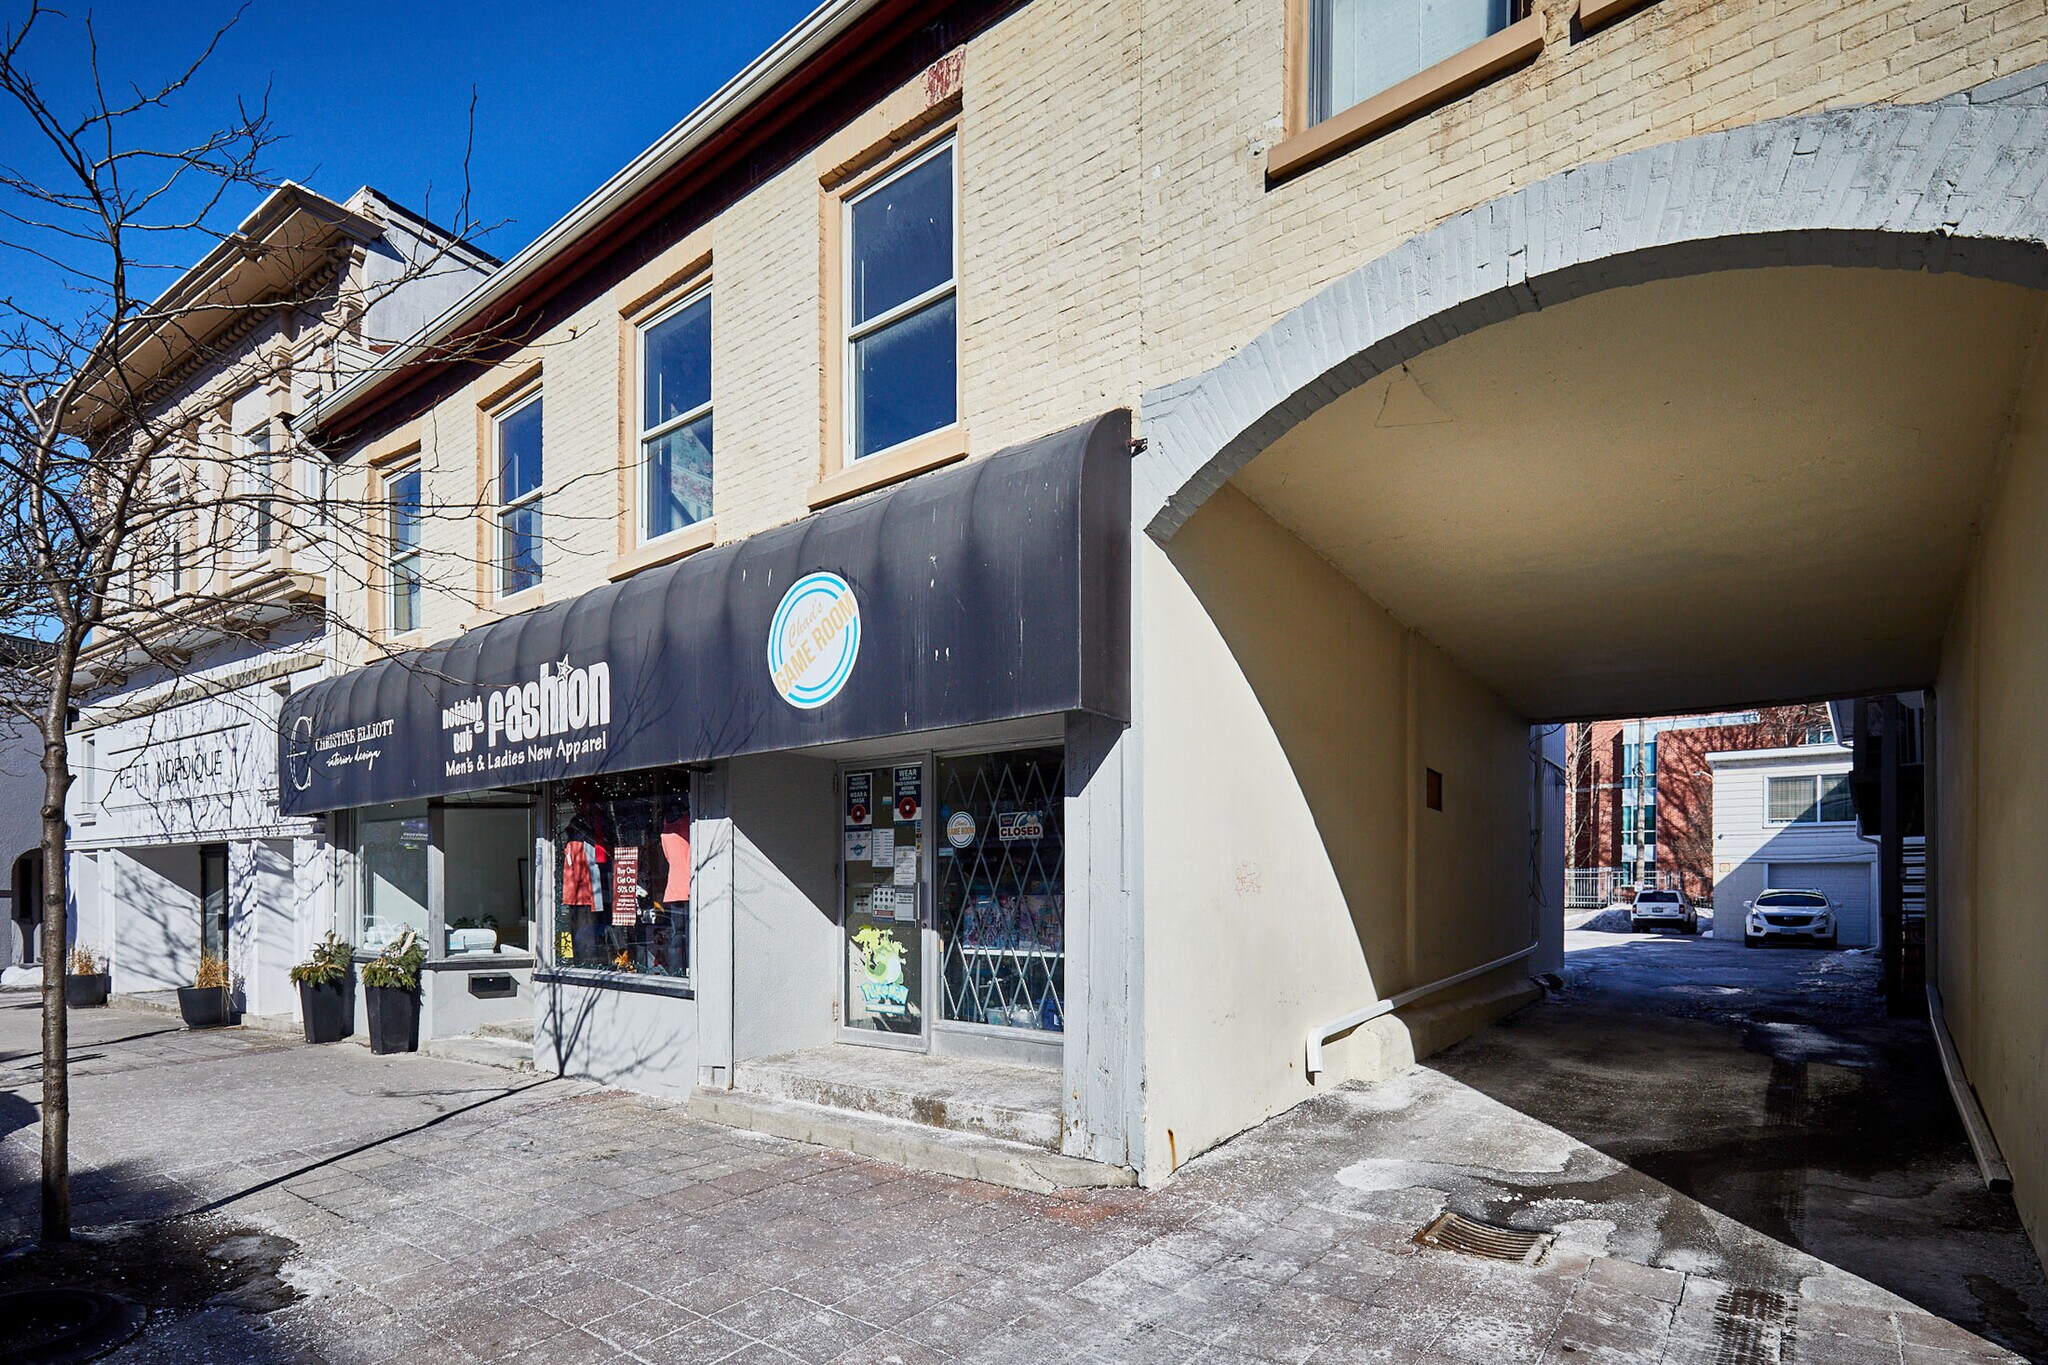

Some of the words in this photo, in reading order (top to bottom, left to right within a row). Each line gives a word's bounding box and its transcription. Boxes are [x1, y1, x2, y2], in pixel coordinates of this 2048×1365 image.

[775, 639, 816, 695] GAME
[812, 592, 857, 651] ROOM
[442, 695, 485, 734] nothing
[488, 654, 611, 748] fashion
[315, 729, 356, 752] CHRISTINE
[446, 756, 474, 777] Men's
[476, 754, 486, 771] &
[488, 745, 526, 770] Ladies
[527, 745, 552, 763] New
[555, 731, 607, 763] Apparel
[157, 750, 223, 784] NORDIQUE
[899, 768, 917, 777] WEAR
[1000, 826, 1041, 837] CLOSED
